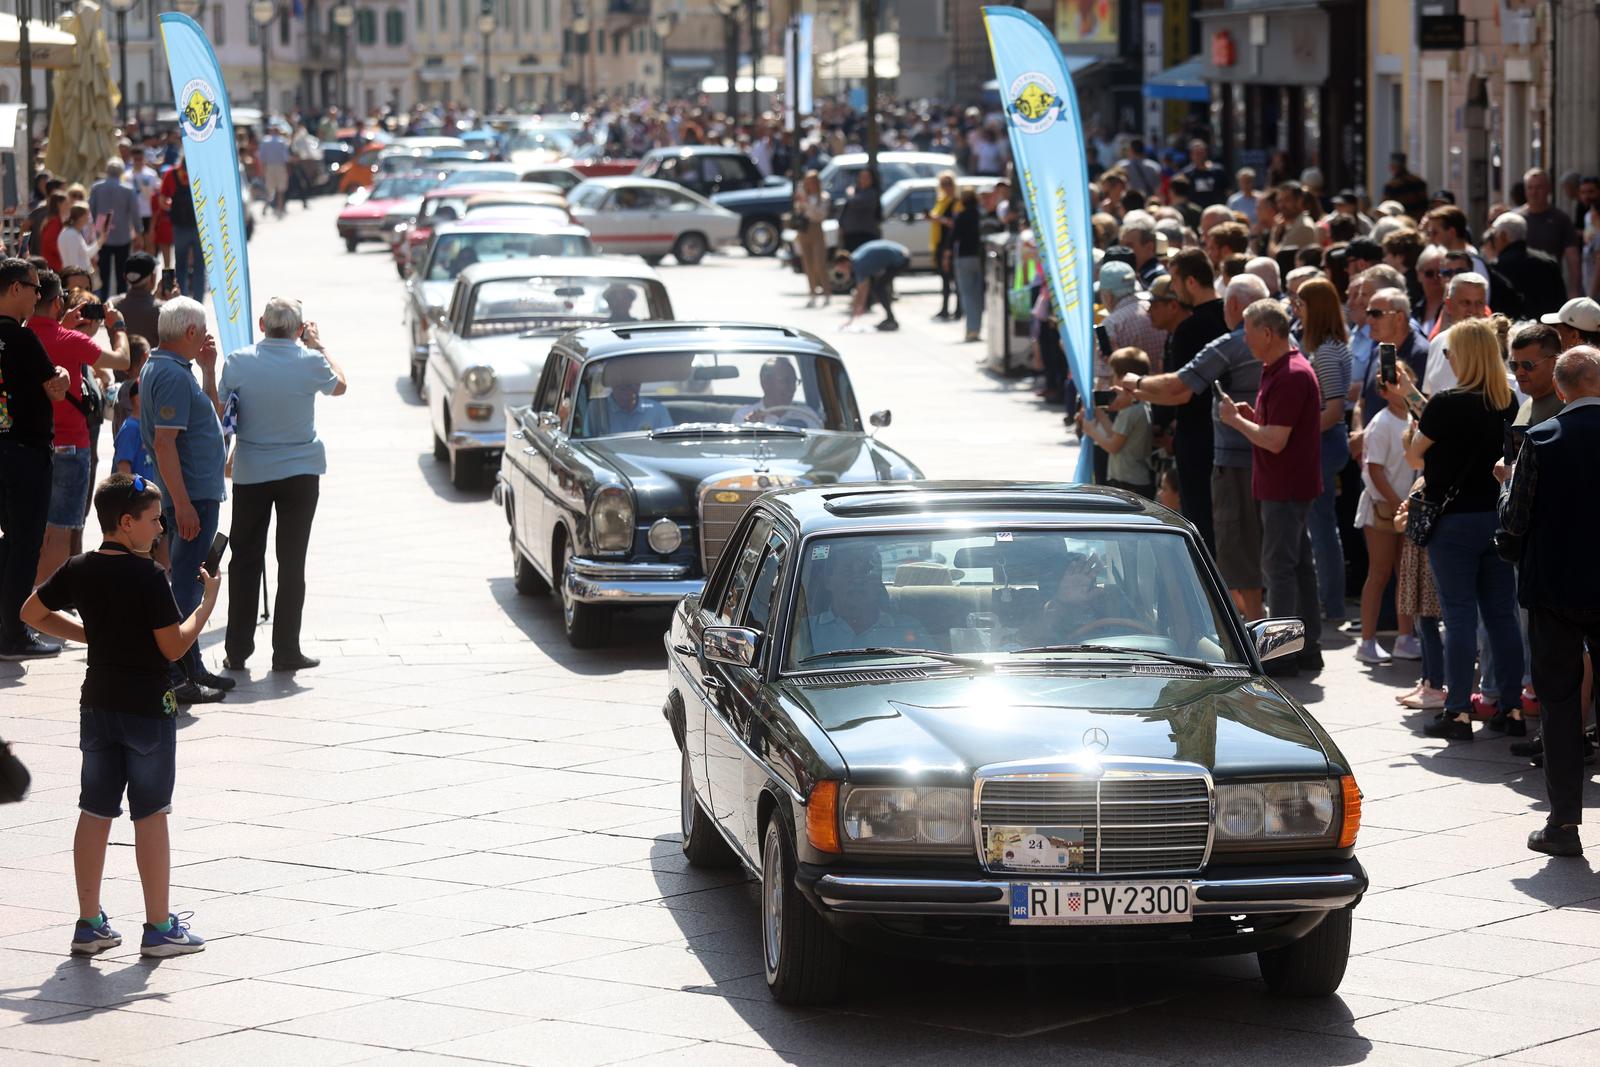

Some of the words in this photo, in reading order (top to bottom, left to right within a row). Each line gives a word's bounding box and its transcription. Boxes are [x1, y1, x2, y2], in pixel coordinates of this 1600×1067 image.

[1028, 839, 1043, 850] 24
[1031, 887, 1060, 916] RI
[1013, 906, 1027, 916] HR
